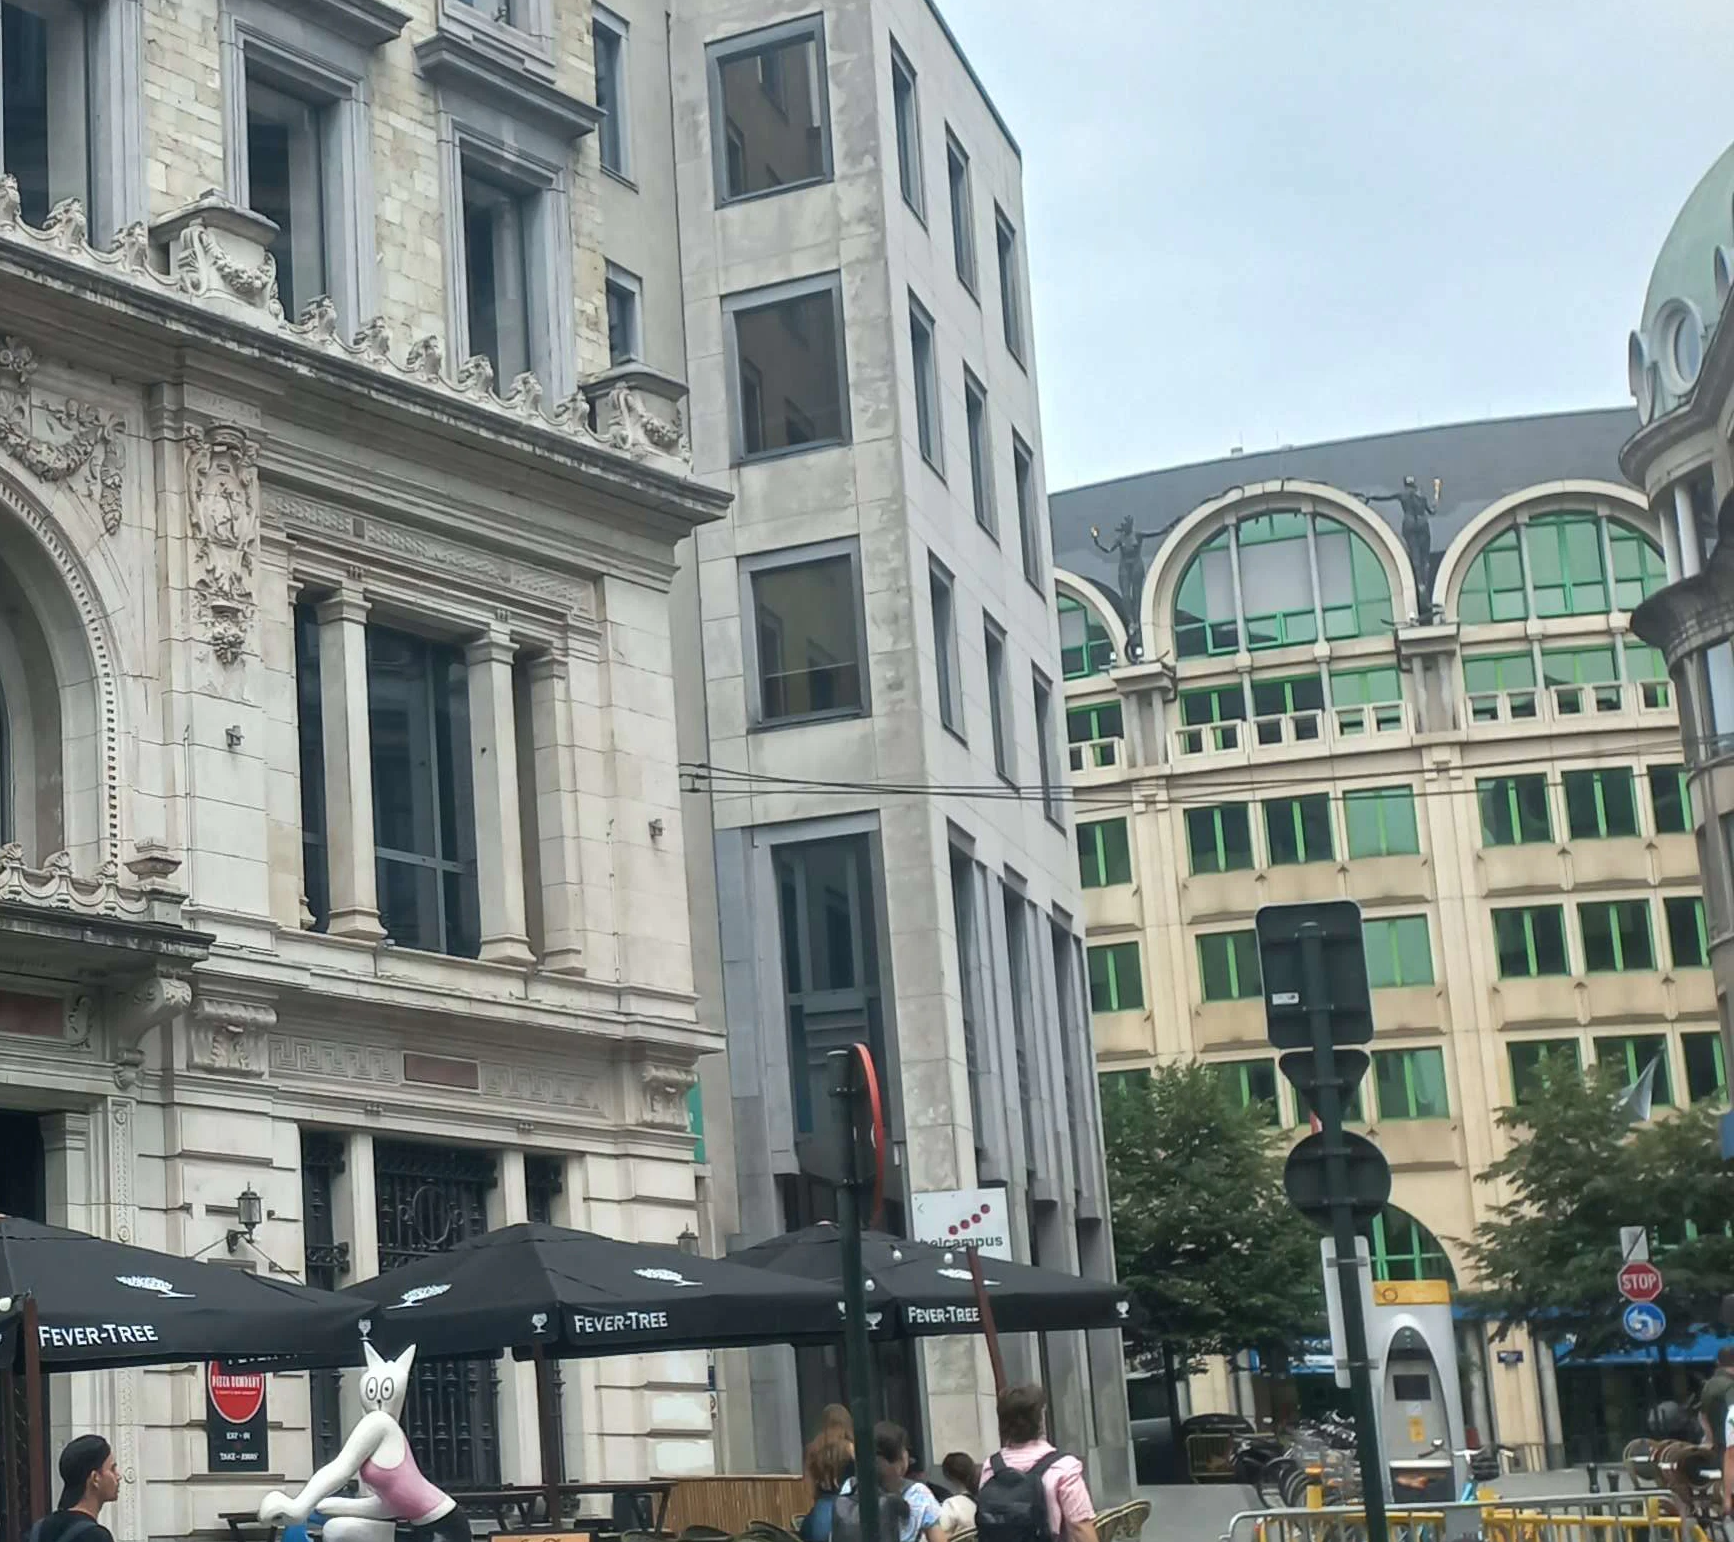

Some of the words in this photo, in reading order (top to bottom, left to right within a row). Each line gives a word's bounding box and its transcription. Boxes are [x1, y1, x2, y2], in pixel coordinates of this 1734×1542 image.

[1621, 1273, 1658, 1291] STOP
[574, 1311, 669, 1334] FEVER-TREE
[907, 1306, 981, 1324] FEVER-TREE
[38, 1324, 159, 1348] FEVER-TREE
